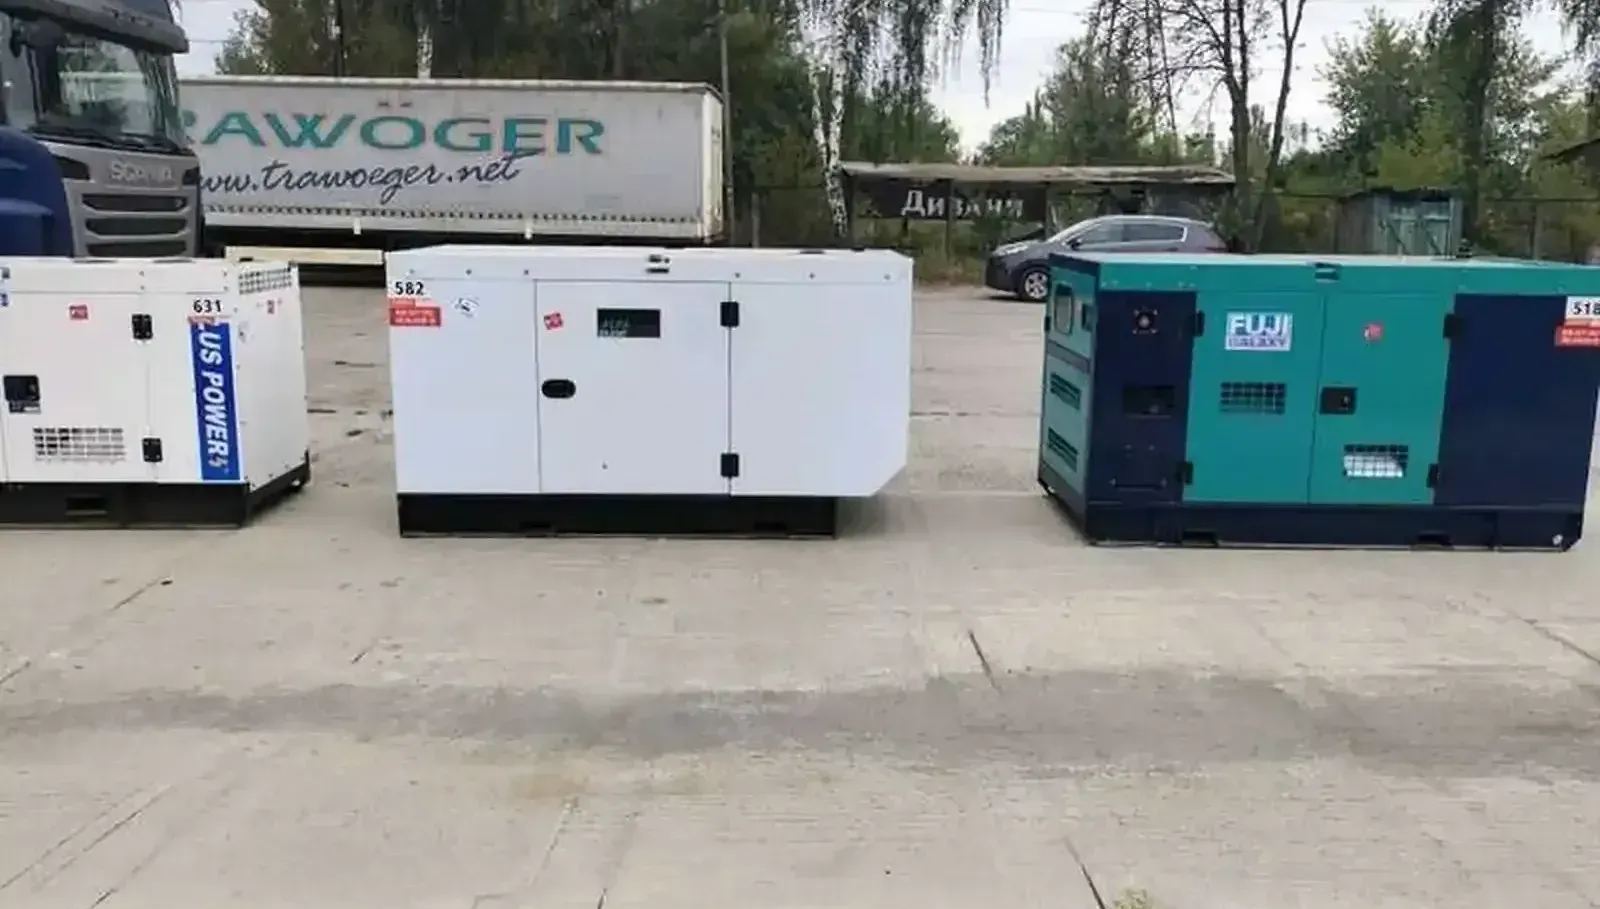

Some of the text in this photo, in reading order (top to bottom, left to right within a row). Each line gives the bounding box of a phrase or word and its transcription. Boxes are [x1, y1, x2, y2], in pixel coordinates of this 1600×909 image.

[395, 281, 424, 296] 582
[193, 299, 222, 313] 631
[1573, 300, 1600, 315] 518
[1230, 314, 1288, 335] FUJI
[201, 370, 230, 457] POWER
